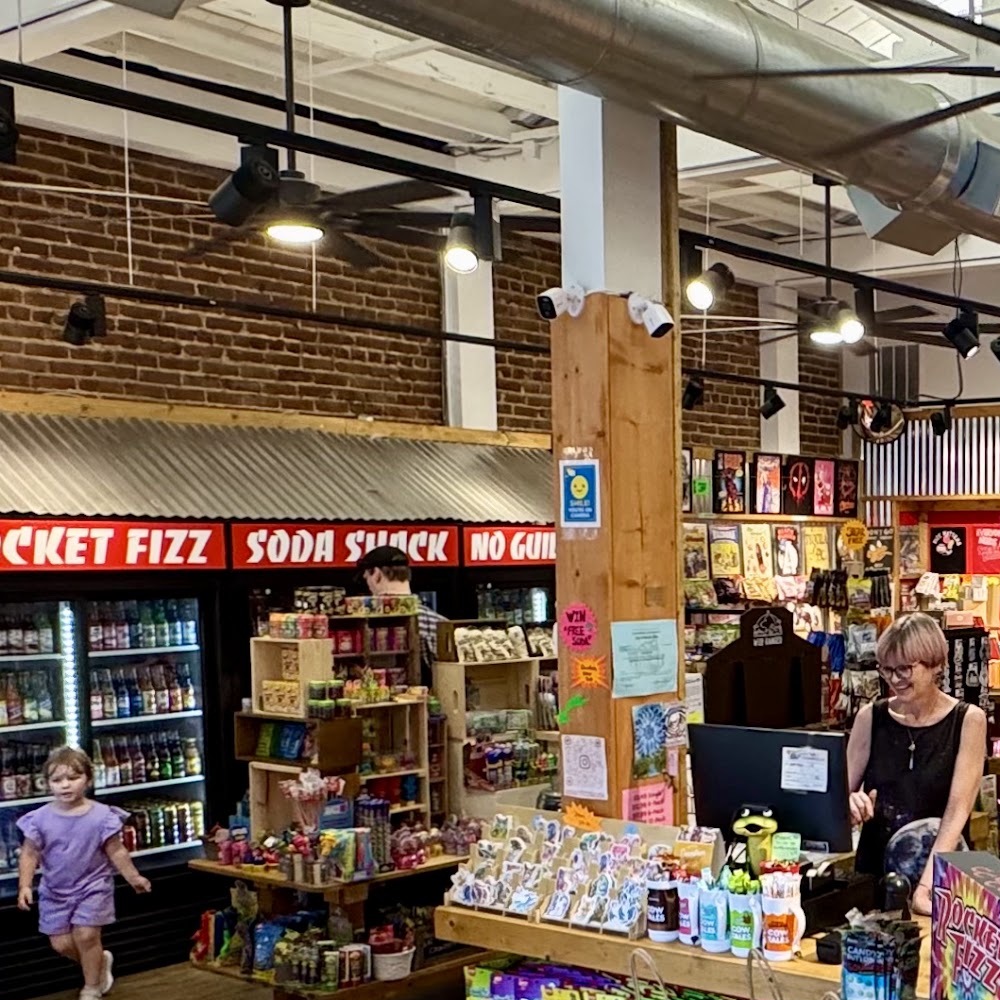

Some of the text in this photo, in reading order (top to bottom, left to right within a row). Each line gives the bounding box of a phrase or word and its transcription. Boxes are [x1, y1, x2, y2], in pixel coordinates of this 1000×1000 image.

[0, 526, 212, 565] CKET FIZZ
[246, 529, 335, 563] SODA
[471, 532, 506, 560] NO
[566, 610, 586, 622] WIN
[767, 929, 788, 937] COW
